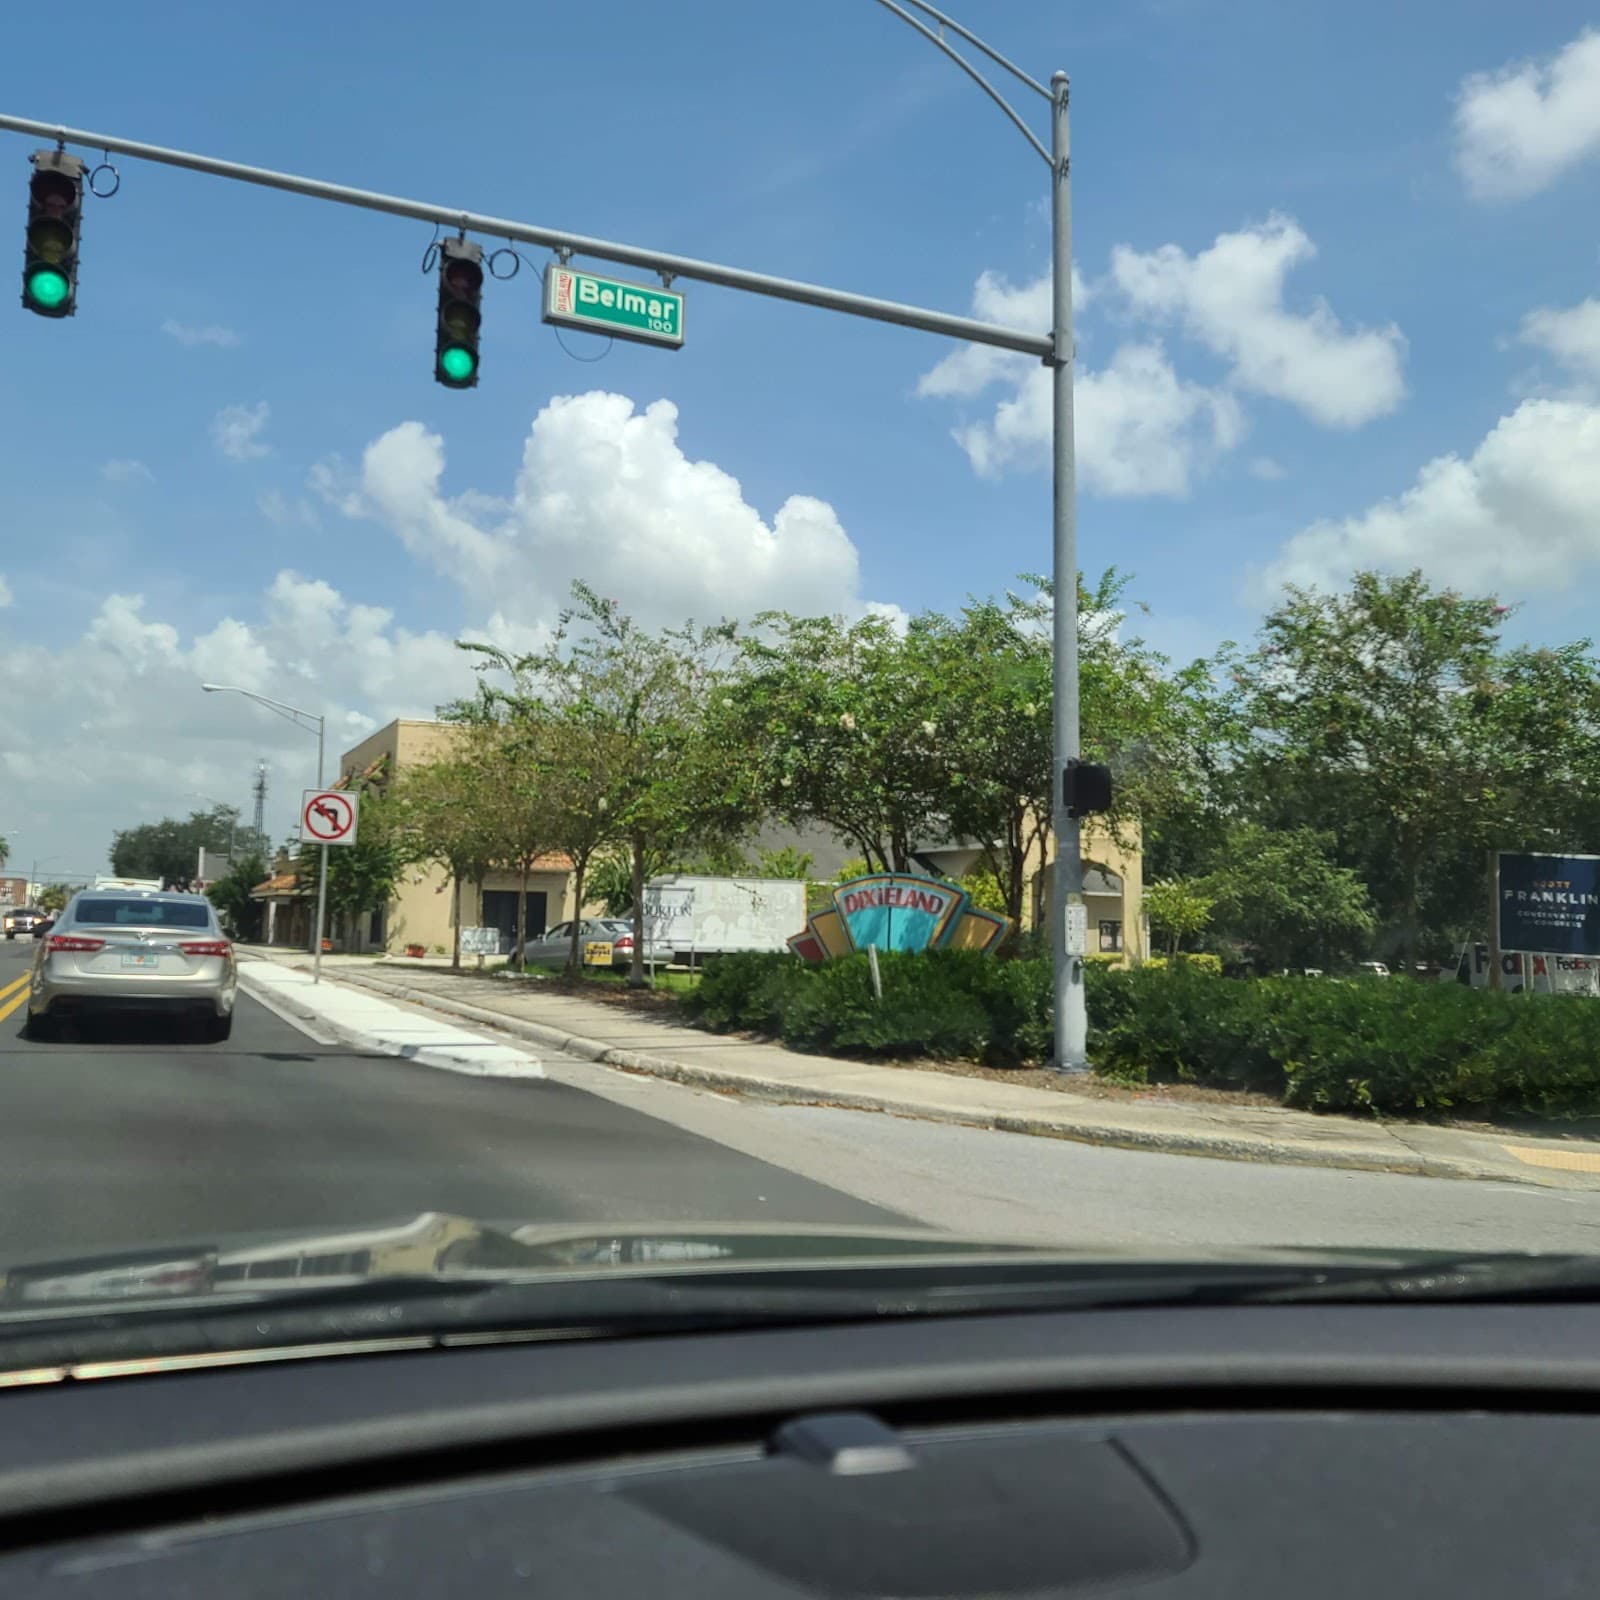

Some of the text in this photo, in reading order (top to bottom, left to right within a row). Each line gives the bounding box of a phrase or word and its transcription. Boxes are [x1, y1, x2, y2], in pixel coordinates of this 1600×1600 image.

[579, 279, 675, 320] Belmar
[648, 317, 673, 333] 100
[844, 887, 945, 914] DIXIELAND
[1504, 890, 1599, 905] FRANKLIN
